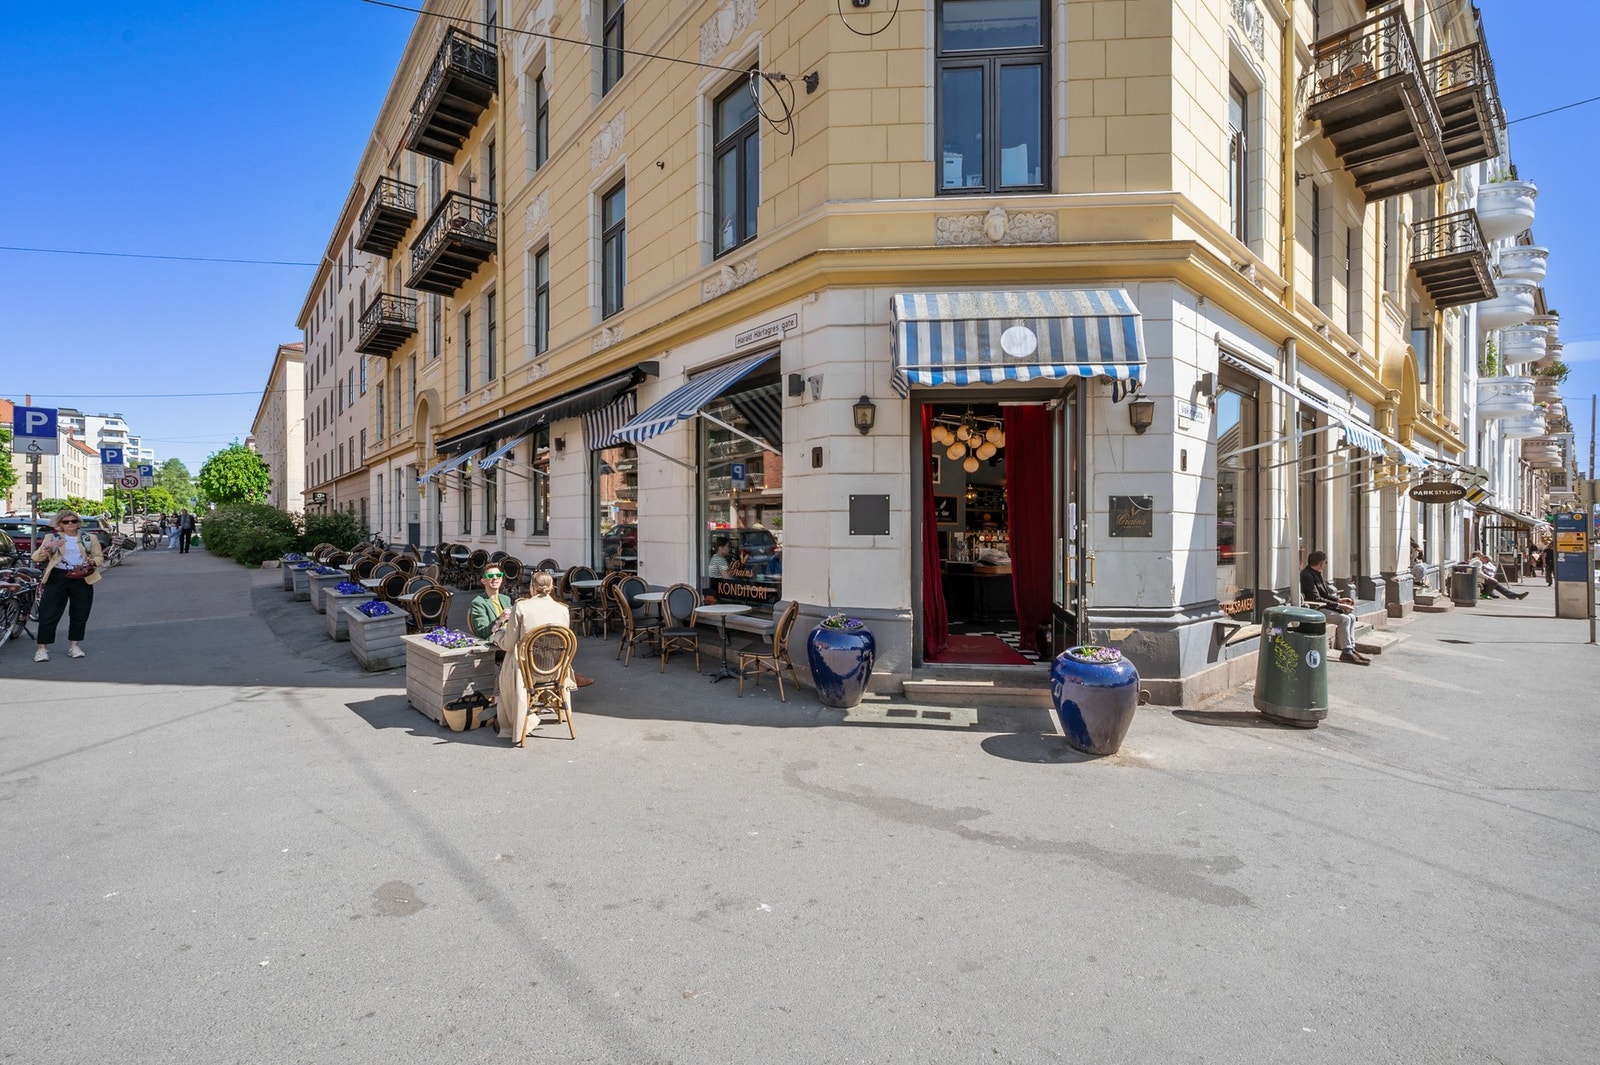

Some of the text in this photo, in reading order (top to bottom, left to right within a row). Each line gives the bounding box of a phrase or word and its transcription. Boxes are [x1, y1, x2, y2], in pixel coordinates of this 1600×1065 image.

[737, 319, 795, 345] Harald Hårfagres gate
[25, 411, 49, 434] P
[105, 450, 118, 463] P
[140, 466, 150, 476] P
[125, 478, 136, 486] 30
[718, 582, 768, 600] KONDITORI
